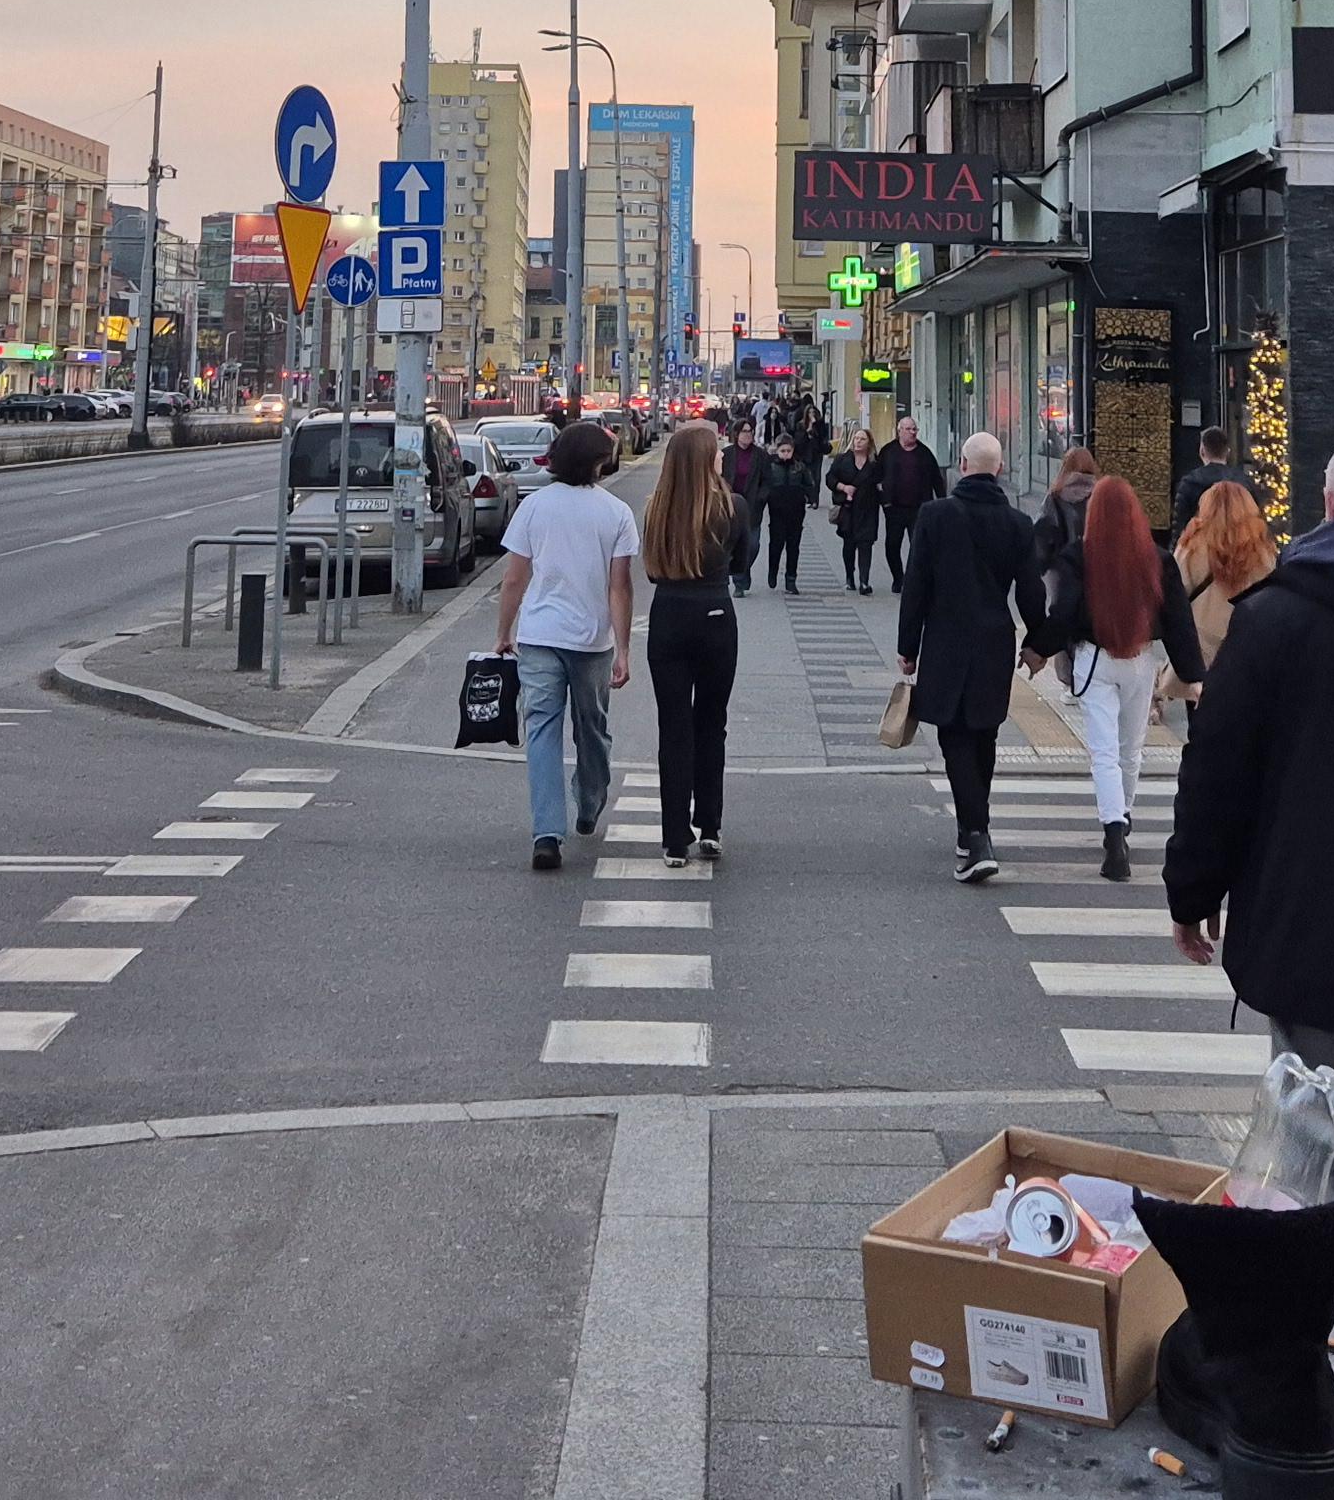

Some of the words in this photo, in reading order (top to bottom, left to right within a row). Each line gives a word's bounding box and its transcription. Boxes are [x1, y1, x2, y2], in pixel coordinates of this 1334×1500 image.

[603, 109, 630, 119] DM
[803, 159, 984, 202] INDIA
[802, 208, 984, 233] KATHMANDU
[392, 237, 427, 289] P
